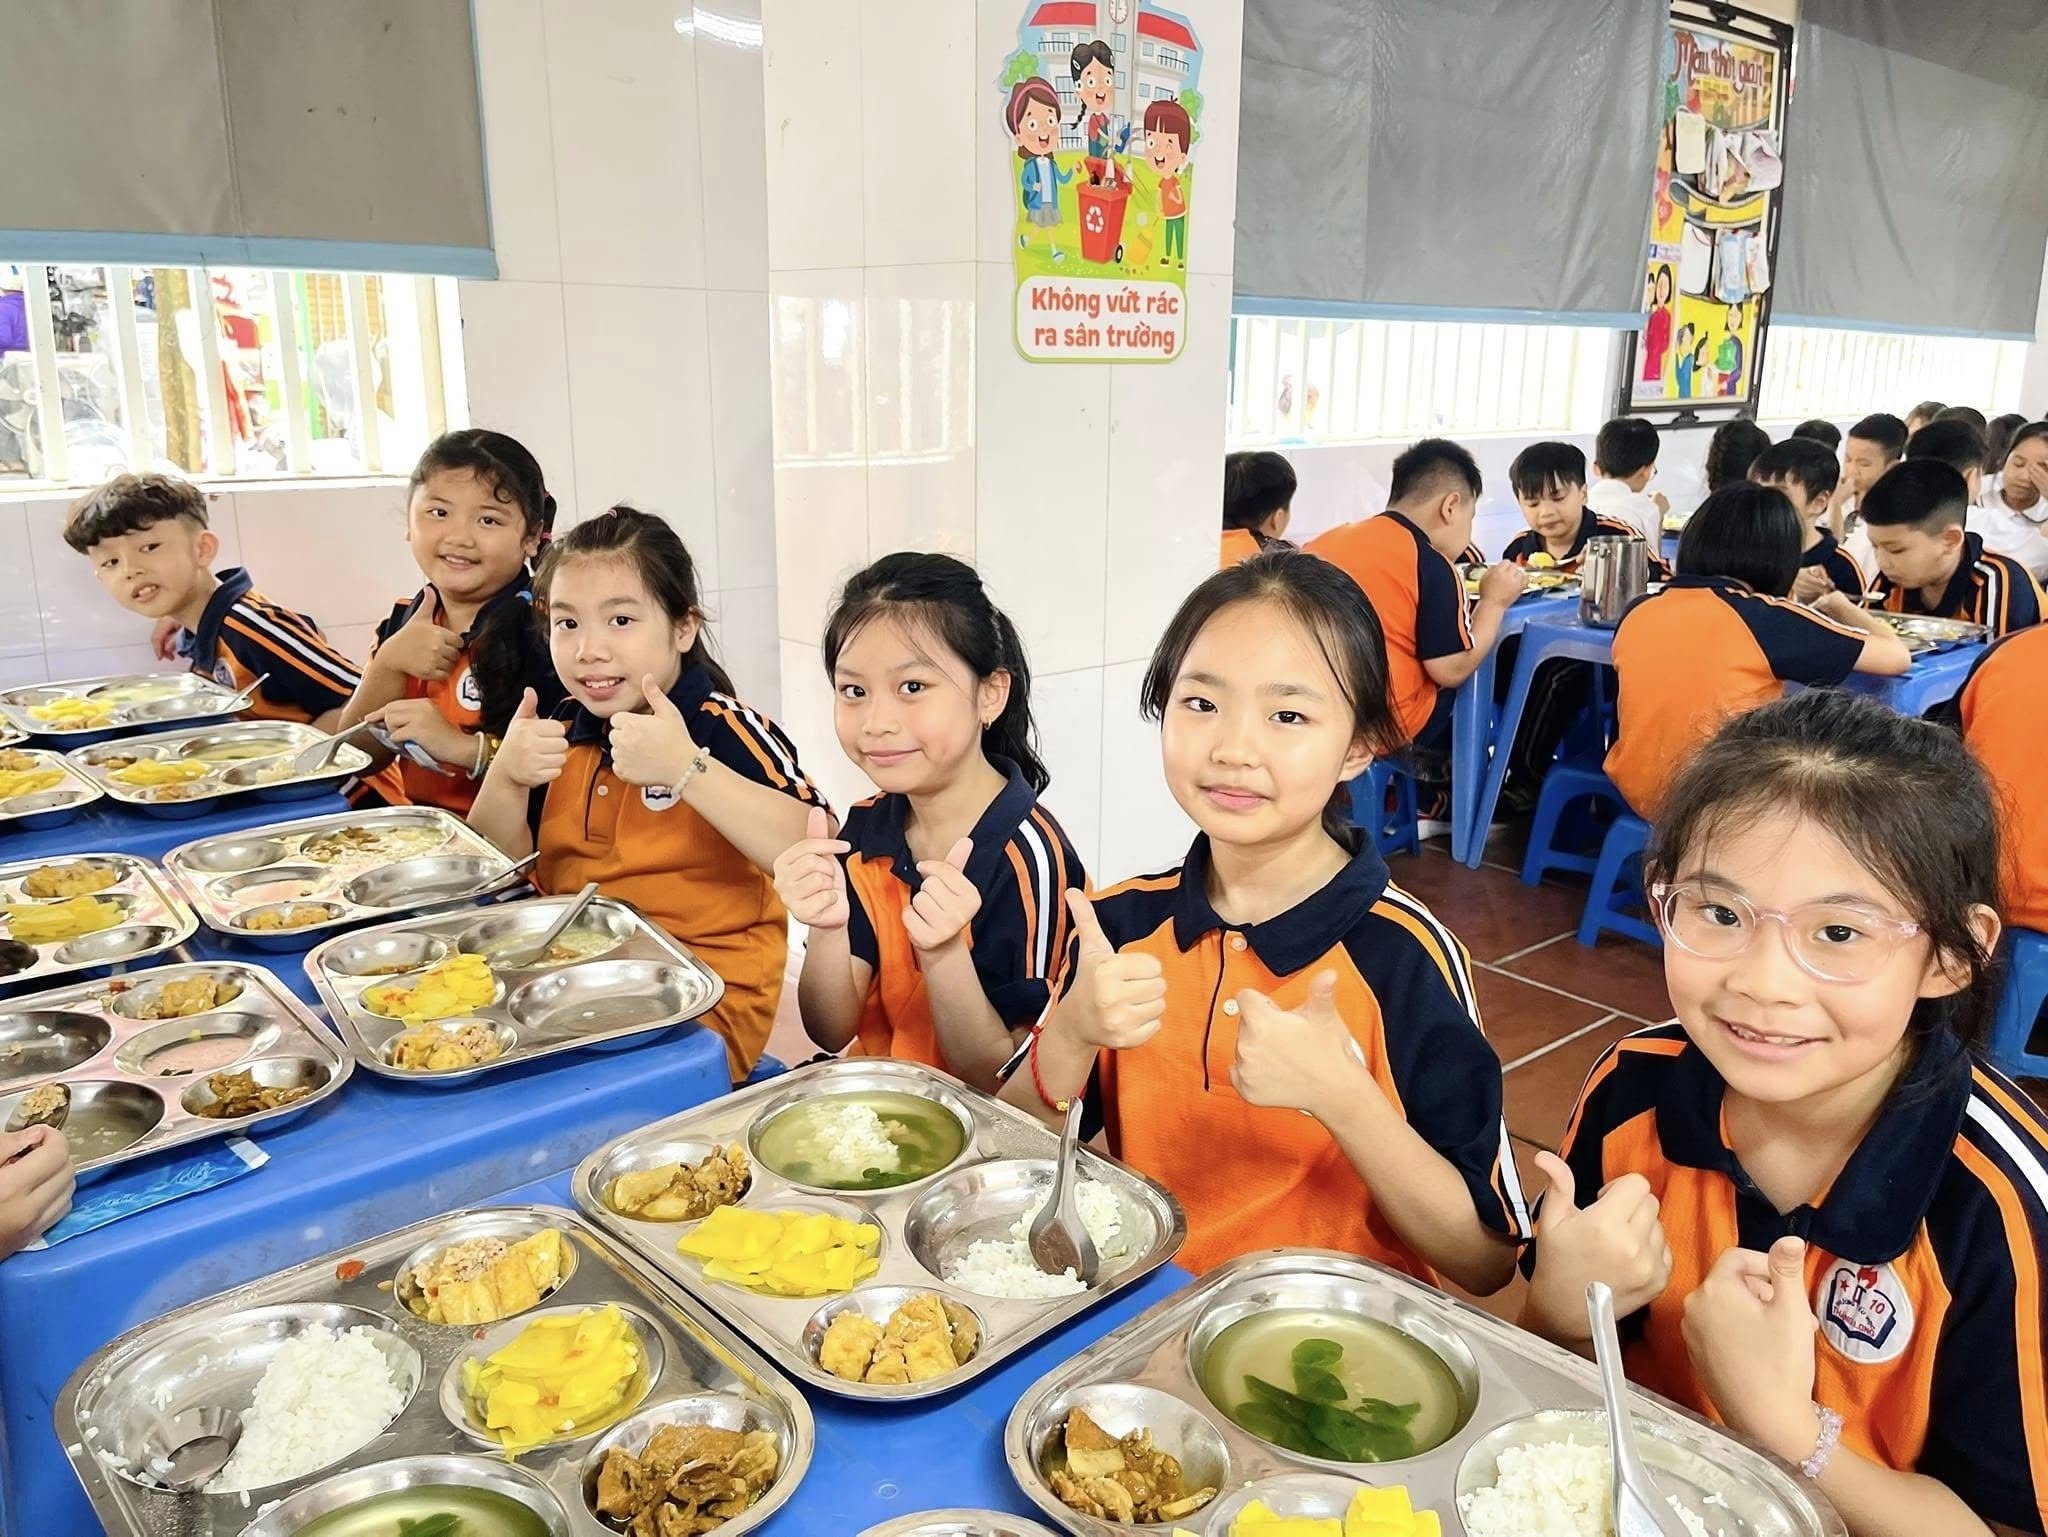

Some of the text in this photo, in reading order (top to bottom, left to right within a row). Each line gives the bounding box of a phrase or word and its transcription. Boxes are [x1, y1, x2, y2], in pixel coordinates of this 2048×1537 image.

[1032, 286, 1178, 319] Không vứt rác
[1035, 321, 1175, 354] ra sân trường
[1869, 1299, 1885, 1314] 10
